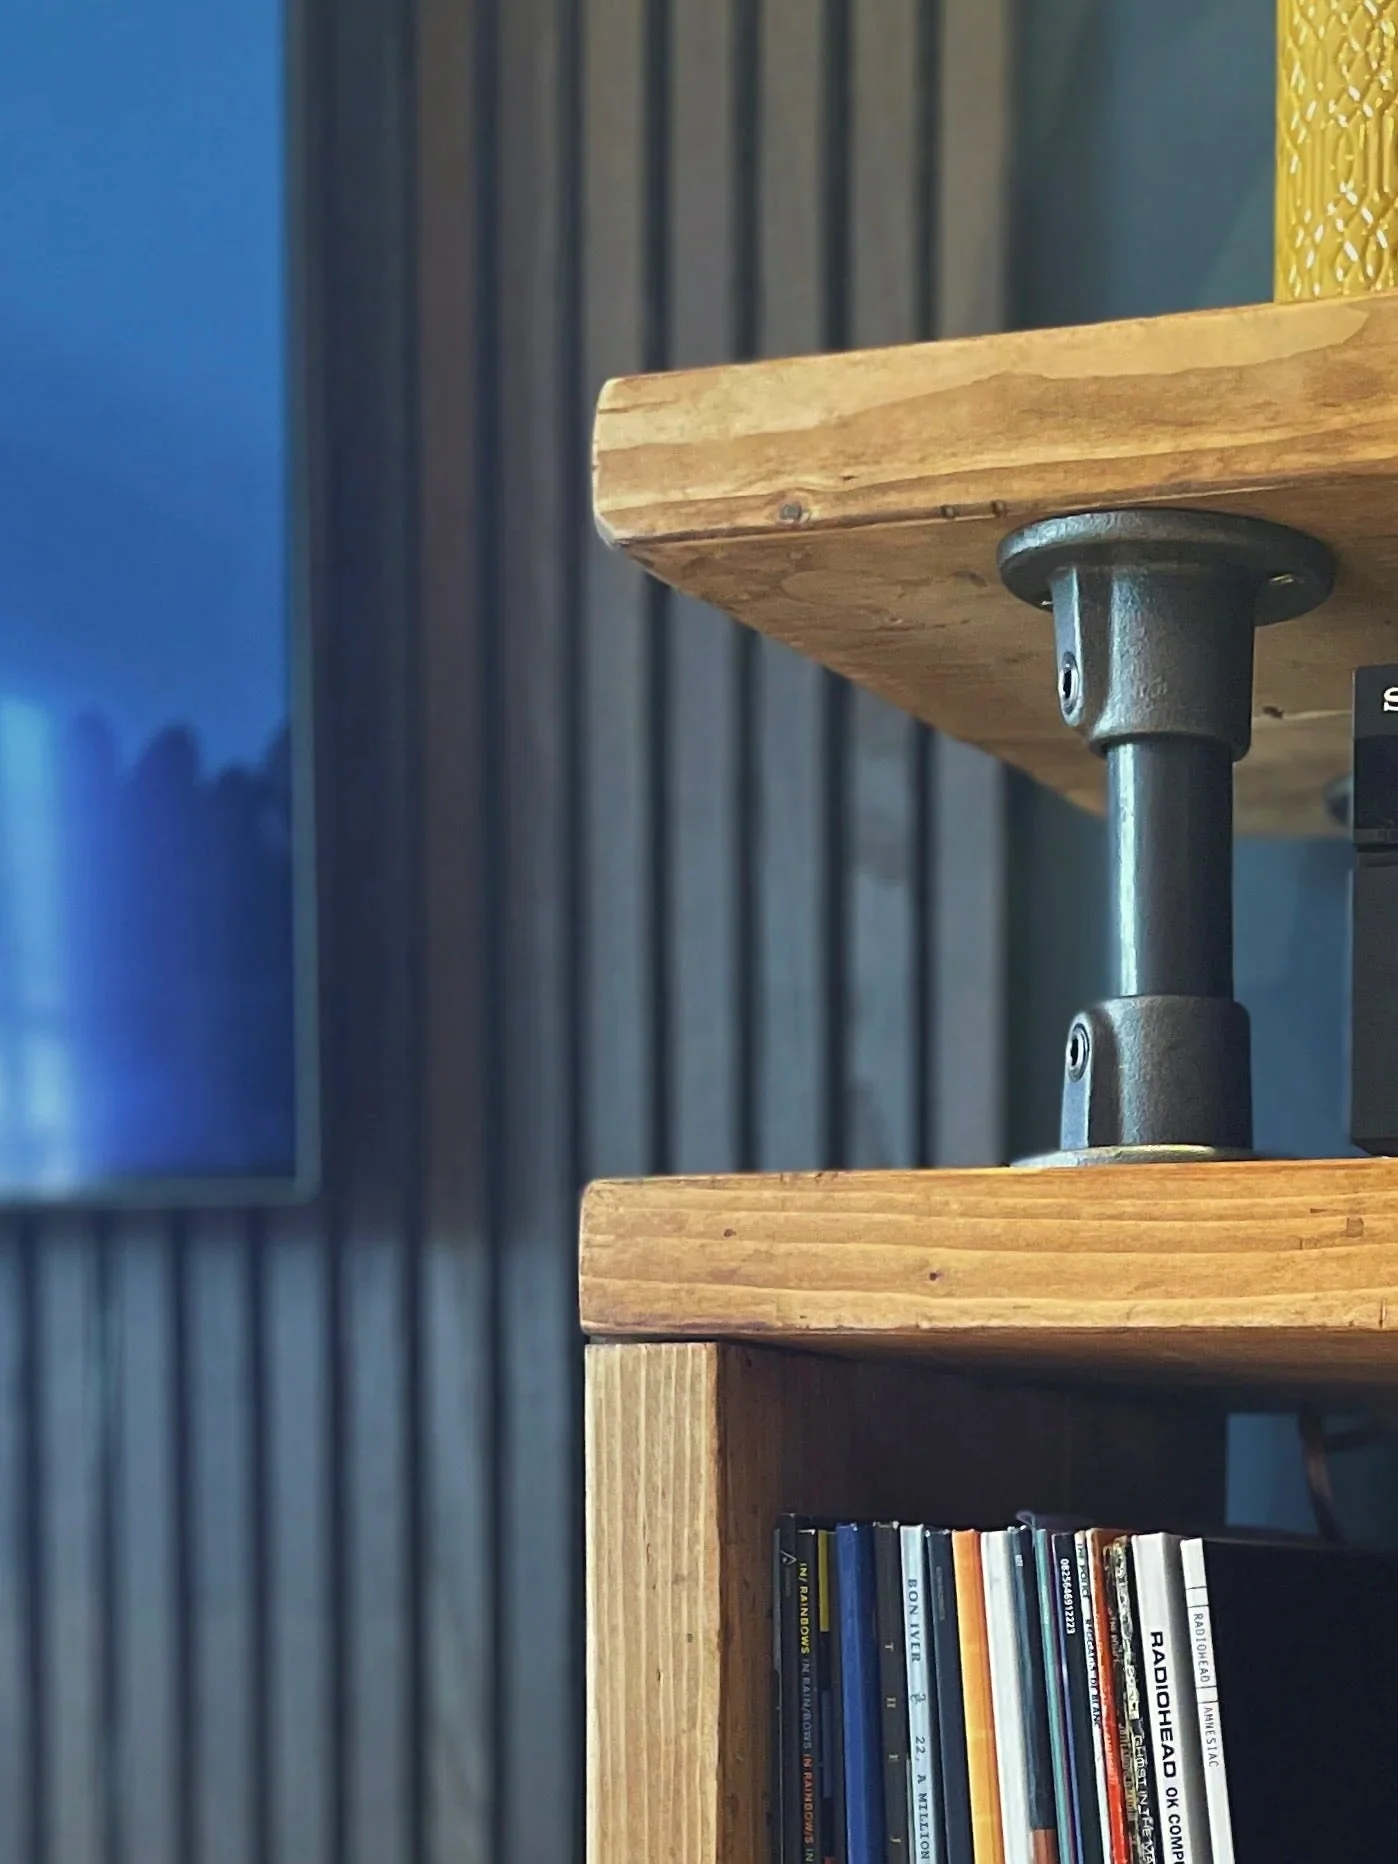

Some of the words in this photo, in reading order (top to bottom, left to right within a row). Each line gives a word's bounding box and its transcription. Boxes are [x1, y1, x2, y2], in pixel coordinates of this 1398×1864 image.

[907, 1578, 919, 1616] BON
[1059, 1558, 1076, 1634] 0825646912223
[799, 1586, 811, 1654] RAINBOWS
[909, 1622, 921, 1663] IVER
[1193, 1612, 1211, 1683] RADIOHEAD
[1203, 1706, 1219, 1769] AMNESIAC
[1150, 1631, 1177, 1778] RADIOHEAD
[1165, 1787, 1182, 1809] OK
[804, 1753, 812, 1767] IN
[915, 1735, 926, 1762] 22,
[917, 1774, 927, 1785] A
[1138, 1790, 1149, 1805] IN
[918, 1792, 931, 1860] MILLION
[805, 1849, 814, 1862] IN
